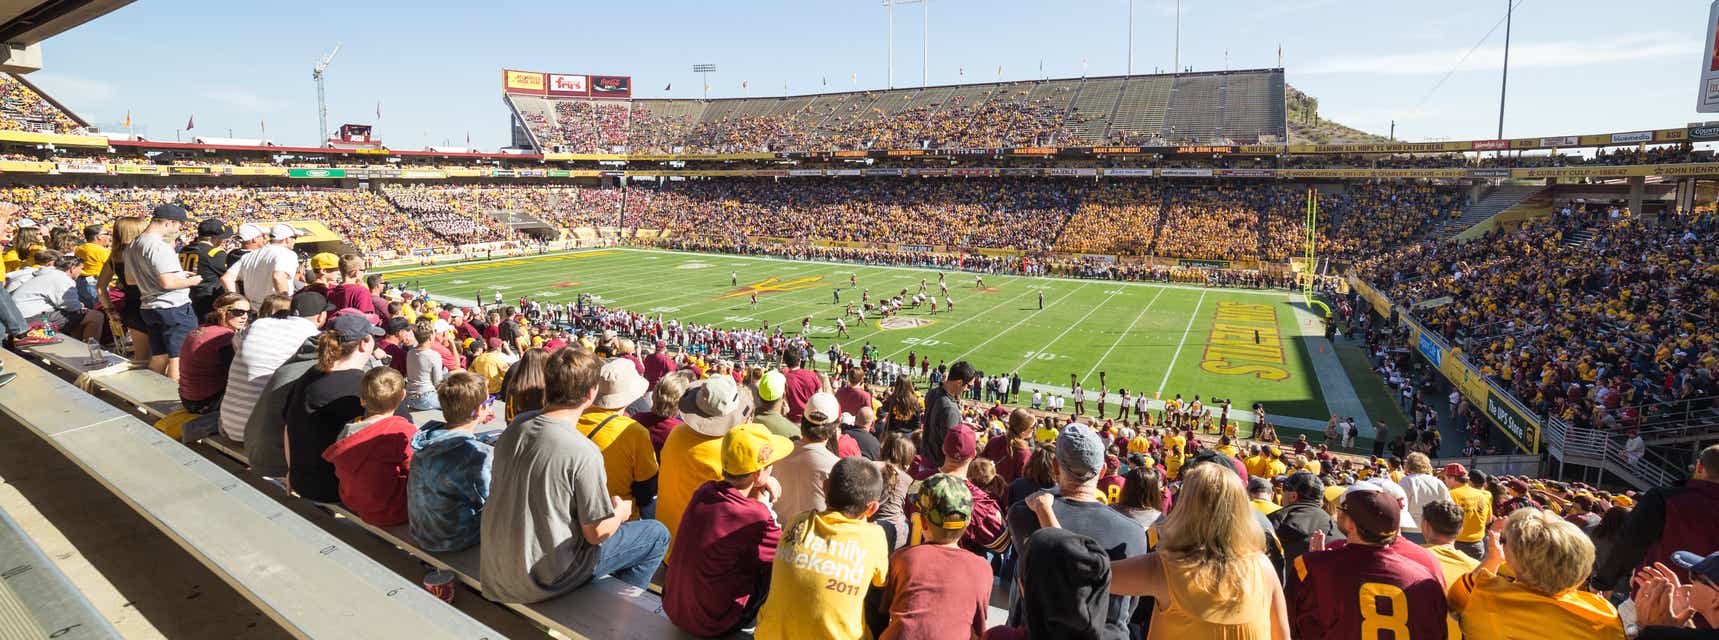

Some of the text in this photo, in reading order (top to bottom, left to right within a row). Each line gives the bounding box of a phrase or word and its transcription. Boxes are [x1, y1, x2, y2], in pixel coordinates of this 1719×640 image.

[1613, 134, 1650, 142] bluemedia
[1665, 165, 1719, 175] JOHN HENRY
[1488, 398, 1497, 416] The
[1497, 405, 1508, 425] UPS
[1508, 415, 1524, 440] Store
[825, 578, 860, 597] 2011
[1359, 583, 1410, 640] 8
